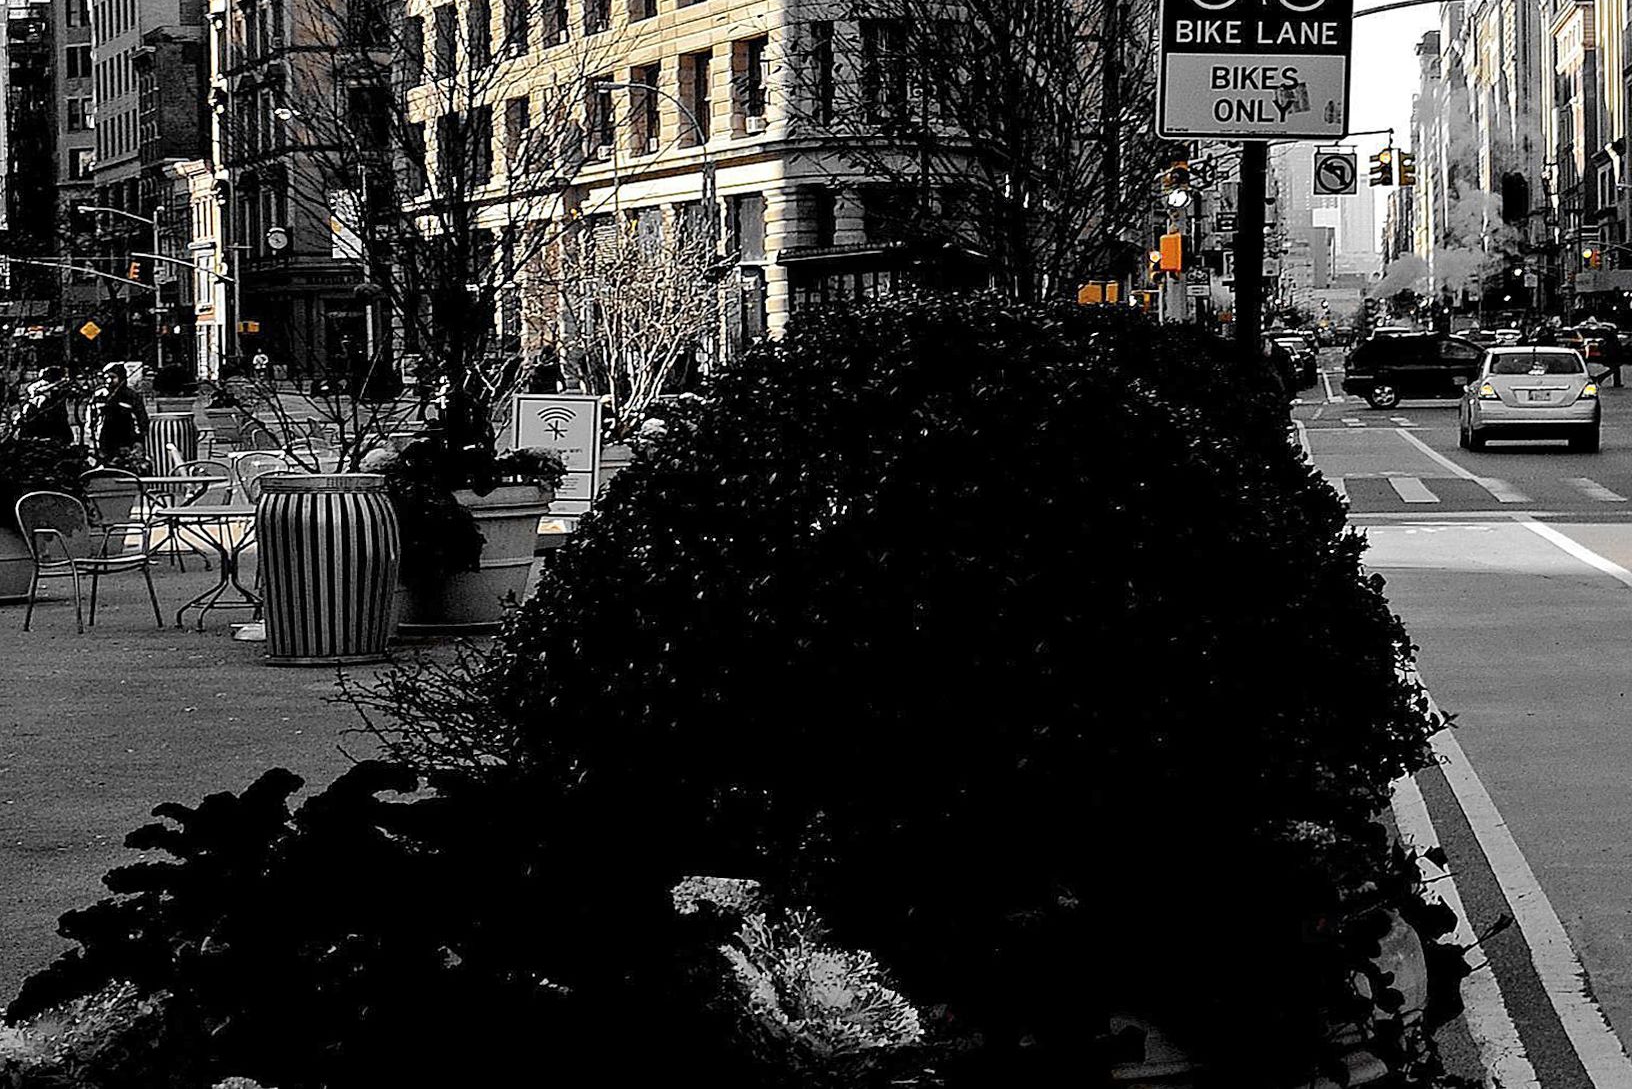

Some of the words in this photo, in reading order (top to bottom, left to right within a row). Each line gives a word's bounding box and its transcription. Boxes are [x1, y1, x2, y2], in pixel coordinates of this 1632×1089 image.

[1176, 20, 1242, 44] BIKE
[1257, 21, 1338, 45] LANE
[1211, 66, 1299, 90] BIKES
[1213, 98, 1294, 123] ONLY
